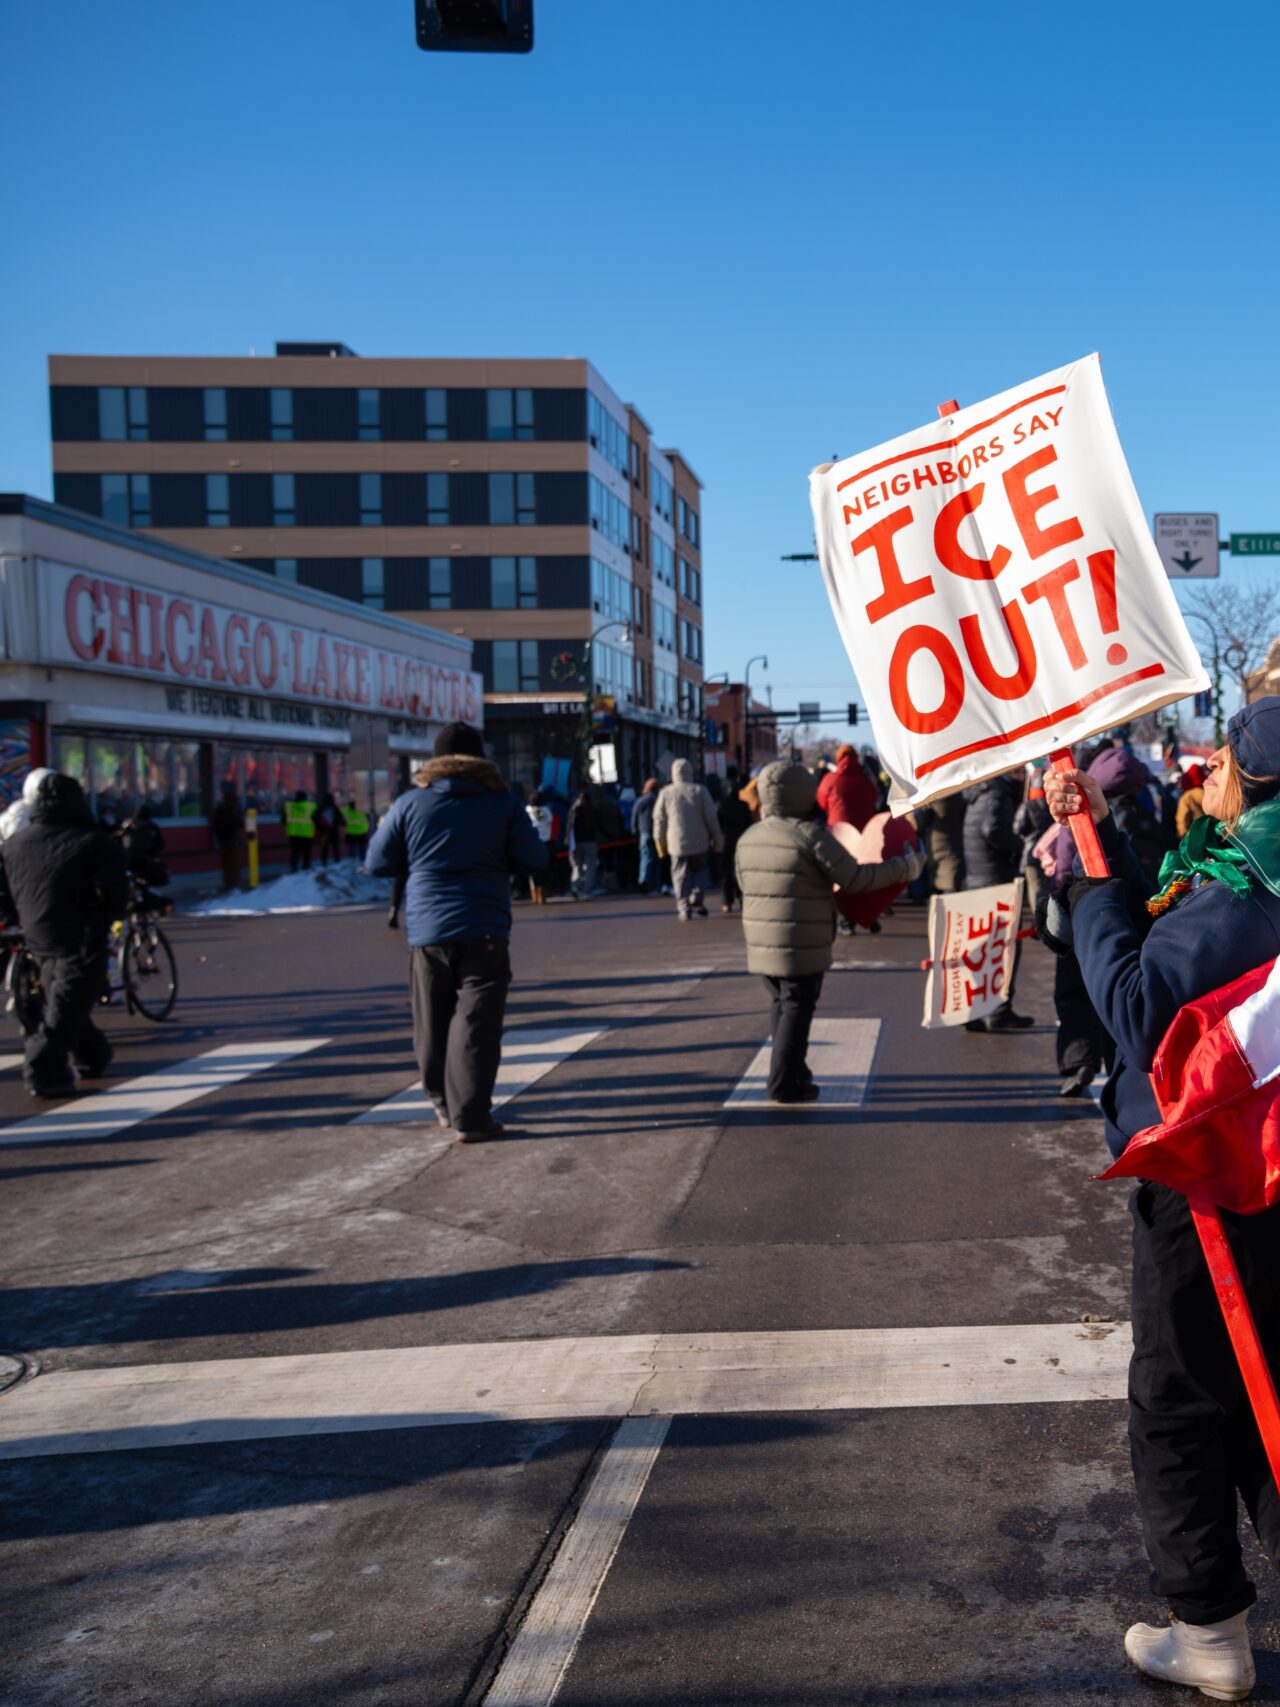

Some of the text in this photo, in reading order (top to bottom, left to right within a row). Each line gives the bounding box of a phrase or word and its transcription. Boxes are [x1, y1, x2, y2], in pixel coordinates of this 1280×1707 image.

[843, 406, 1064, 525] NEIGHBORS SAY
[851, 444, 1085, 625] ICE
[64, 574, 478, 723] CHICAGO LAKE LIQUORS
[888, 549, 1129, 735] OUT!
[952, 938, 962, 1012] NEIGHBORS
[961, 911, 994, 1008] ICE
[991, 901, 1014, 996] OUT!
